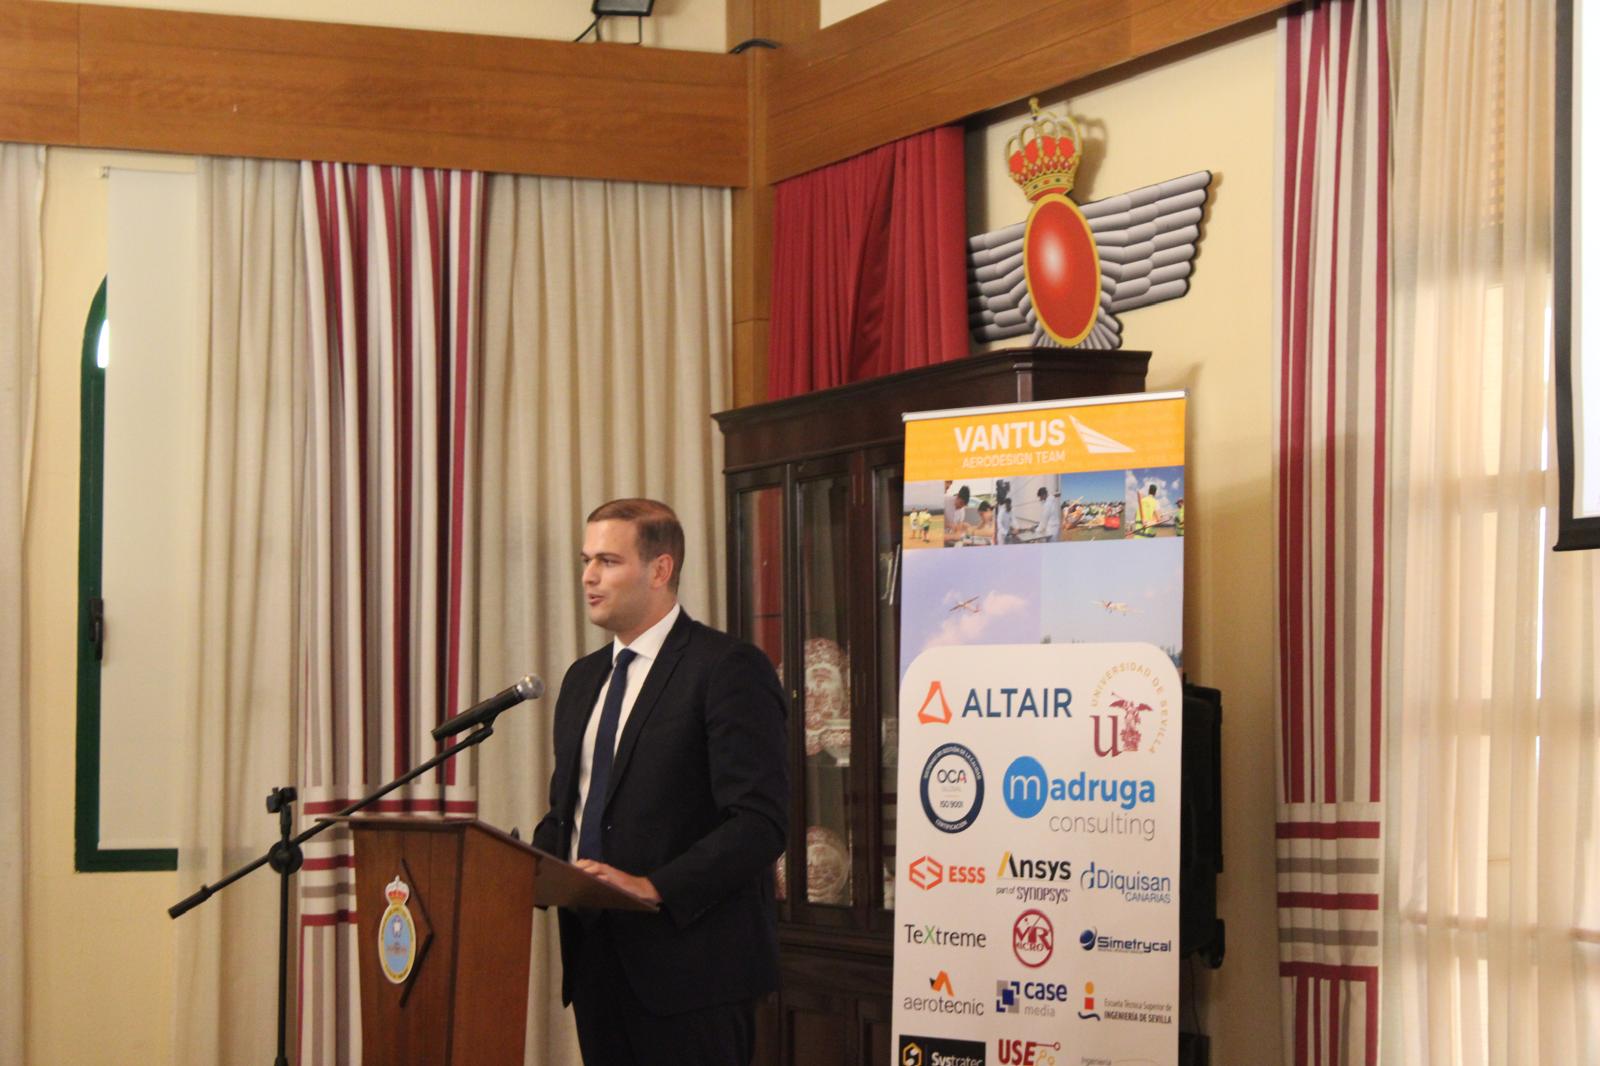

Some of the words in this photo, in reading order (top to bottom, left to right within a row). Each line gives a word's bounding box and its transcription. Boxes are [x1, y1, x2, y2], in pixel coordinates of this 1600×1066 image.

[954, 418, 1066, 453] VANTUS
[962, 451, 1032, 469] AERODESIGN
[1035, 450, 1066, 464] TEAM
[1091, 662, 1152, 707] UNIVERSIDAD
[1152, 678, 1164, 694] DE
[961, 688, 1073, 718] ALTAIR
[1147, 699, 1169, 753] SEVILLA
[937, 769, 968, 784] OCA
[1010, 771, 1156, 811] madruga
[1049, 812, 1157, 842] consulting
[948, 866, 986, 884] ESSS
[997, 851, 1071, 881] Ansys
[996, 886, 1009, 895] part
[1097, 869, 1171, 895] Diquisan
[1125, 892, 1171, 904] CANARIAS
[904, 924, 987, 948] TeXtreme
[1097, 936, 1171, 953] Simetrycal
[1024, 981, 1067, 1002] case
[903, 996, 985, 1016] aerotecnic
[1024, 1004, 1056, 1018] media
[1165, 1004, 1172, 1012] de
[1139, 1013, 1147, 1023] DE
[1148, 1013, 1172, 1024] SEVILLA
